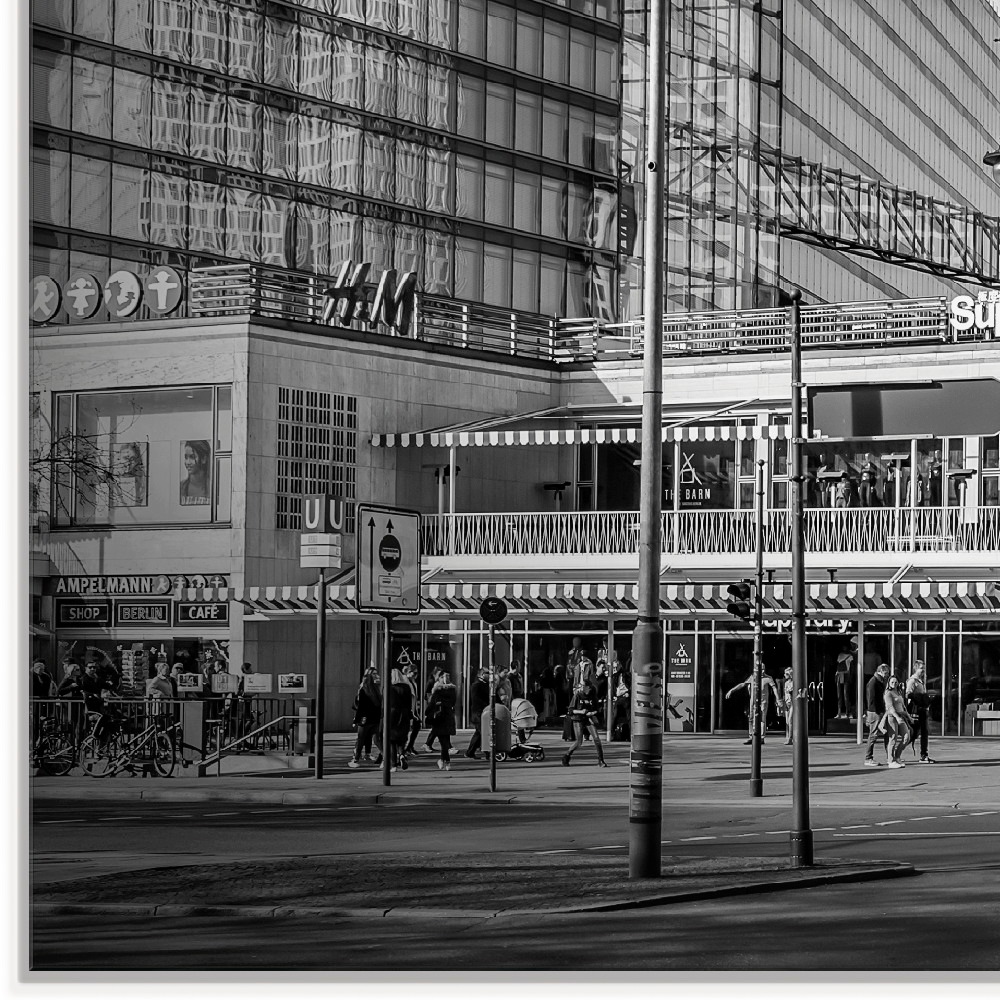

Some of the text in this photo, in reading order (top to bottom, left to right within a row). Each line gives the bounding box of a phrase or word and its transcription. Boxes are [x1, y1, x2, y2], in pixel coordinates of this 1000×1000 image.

[664, 488, 711, 501] TH BARN
[305, 498, 320, 530] U
[329, 499, 344, 530] U
[56, 576, 153, 594] AMPELMANN
[69, 606, 100, 620] SHOP
[122, 606, 163, 620] BERLIN
[188, 603, 218, 620] CAFÉ
[412, 651, 446, 661] TH BARN
